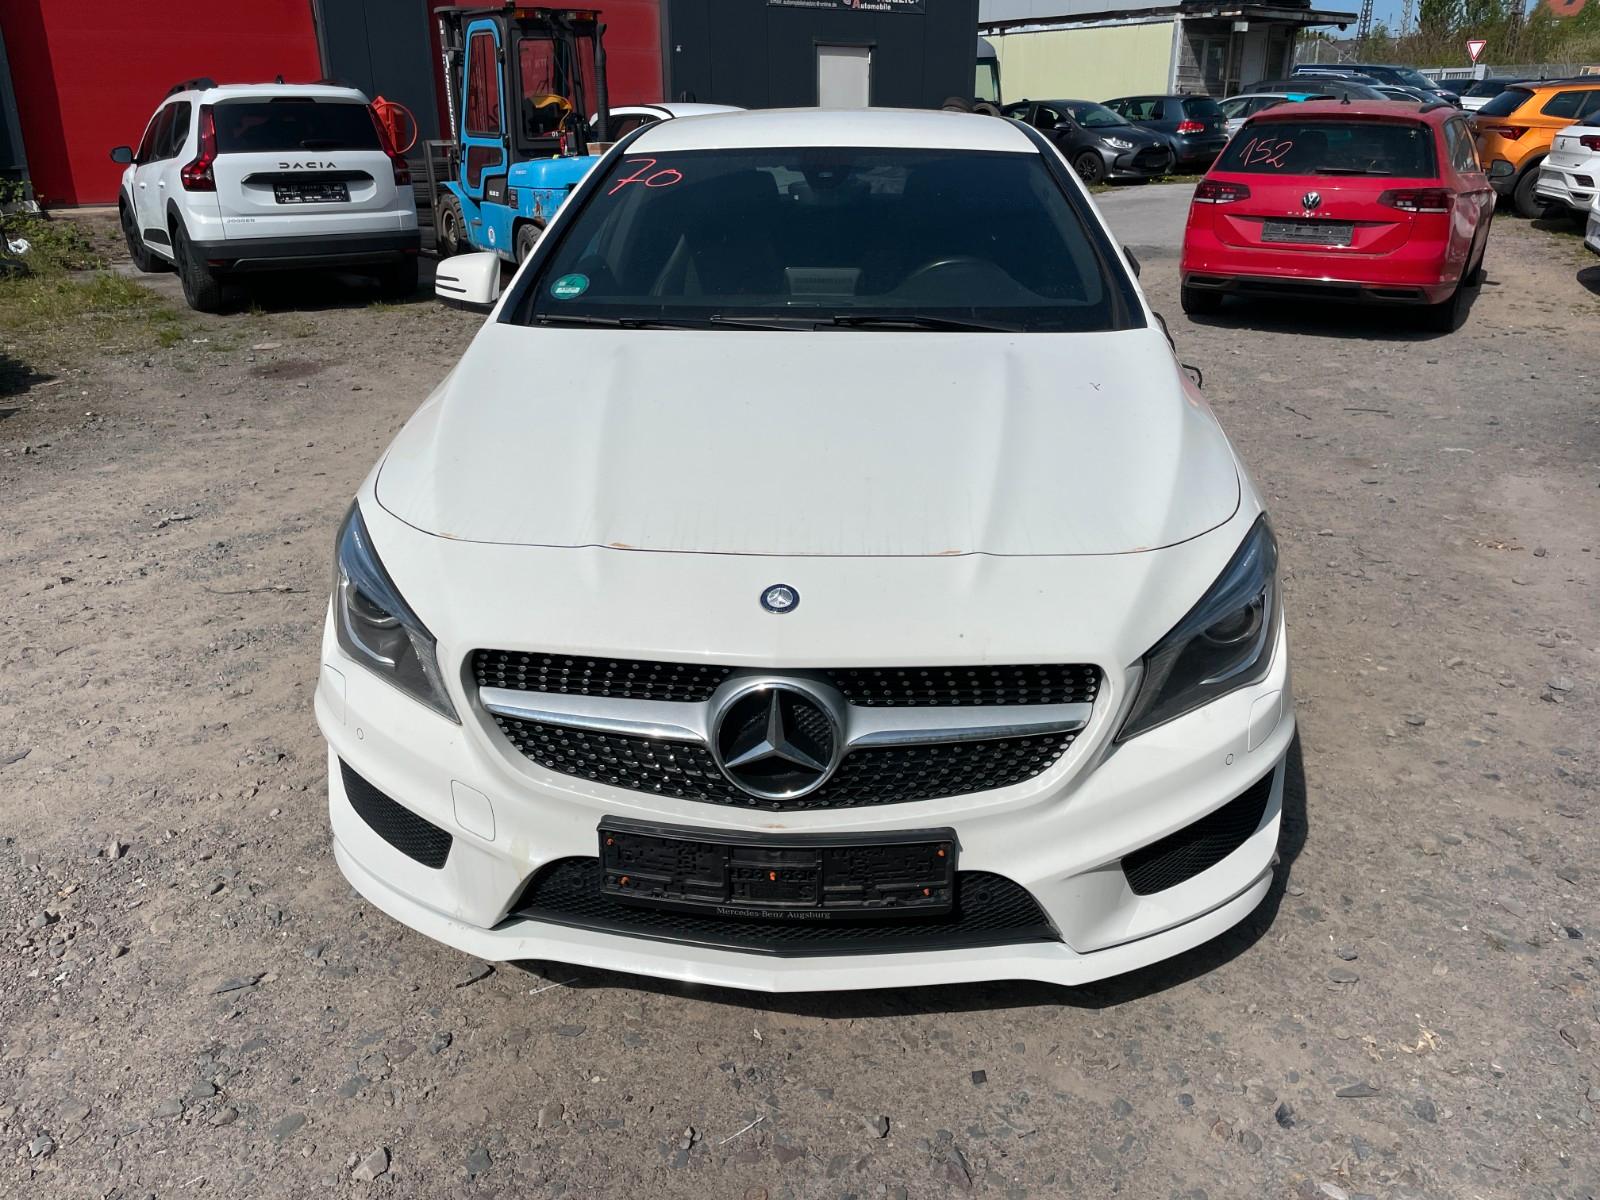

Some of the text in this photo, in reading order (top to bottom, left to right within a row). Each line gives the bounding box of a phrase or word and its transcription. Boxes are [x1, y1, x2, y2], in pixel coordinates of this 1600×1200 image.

[852, 0, 891, 10] Automobile
[1239, 138, 1293, 168] 152
[279, 161, 337, 169] DACIA
[608, 159, 683, 196] 70
[787, 911, 831, 919] Augsburg
